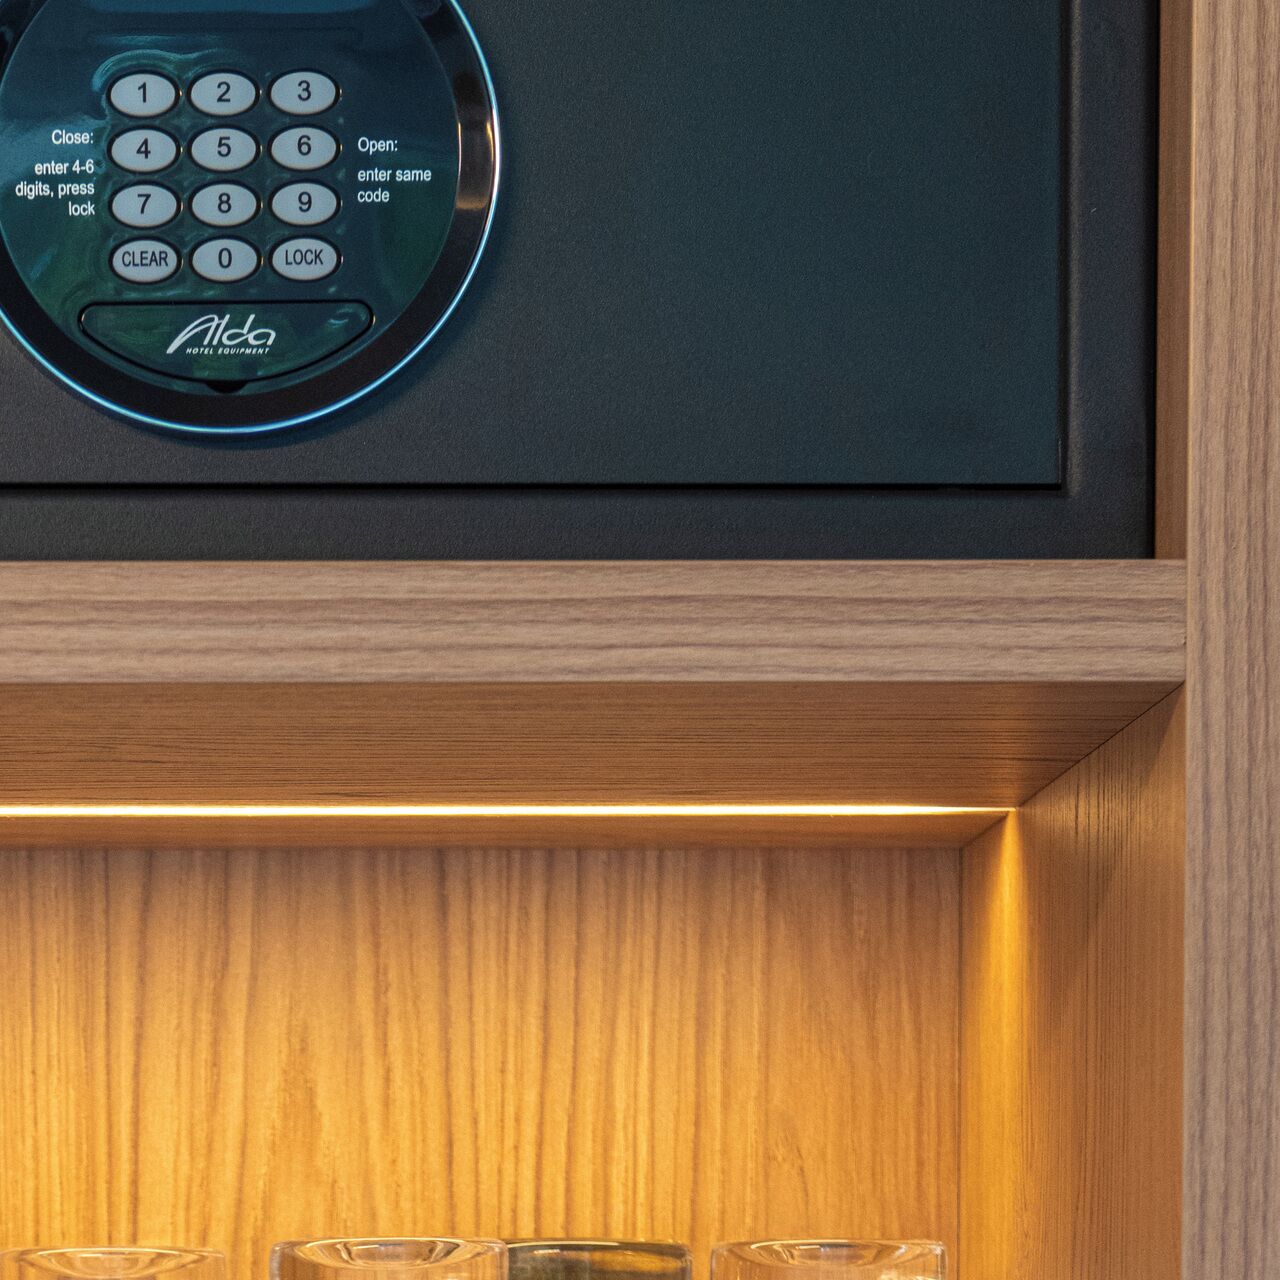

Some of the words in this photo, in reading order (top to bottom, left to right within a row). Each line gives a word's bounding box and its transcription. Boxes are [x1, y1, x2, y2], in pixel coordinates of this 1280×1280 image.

[137, 81, 148, 103] 1
[216, 81, 231, 103] 2
[297, 80, 312, 101] 3
[51, 129, 94, 145] Close:
[217, 136, 232, 158] 5
[297, 135, 312, 156] 6
[357, 136, 398, 155] Open:
[136, 137, 151, 160] 4
[34, 161, 70, 175] enter
[72, 159, 95, 174] 4-6
[357, 167, 393, 182] enter
[395, 169, 432, 182] same
[15, 181, 54, 200] digits,
[58, 182, 95, 199] press
[357, 187, 390, 203] code
[68, 200, 96, 216] lock
[137, 193, 151, 215] 7
[217, 192, 232, 214] 8
[297, 191, 312, 213] 9
[121, 250, 169, 267] CLEAR
[218, 247, 232, 269] 0
[284, 249, 324, 266] LOCK
[166, 314, 276, 354] Alda
[185, 347, 214, 355] HOTEL
[217, 347, 270, 355] EQUIPMENT
